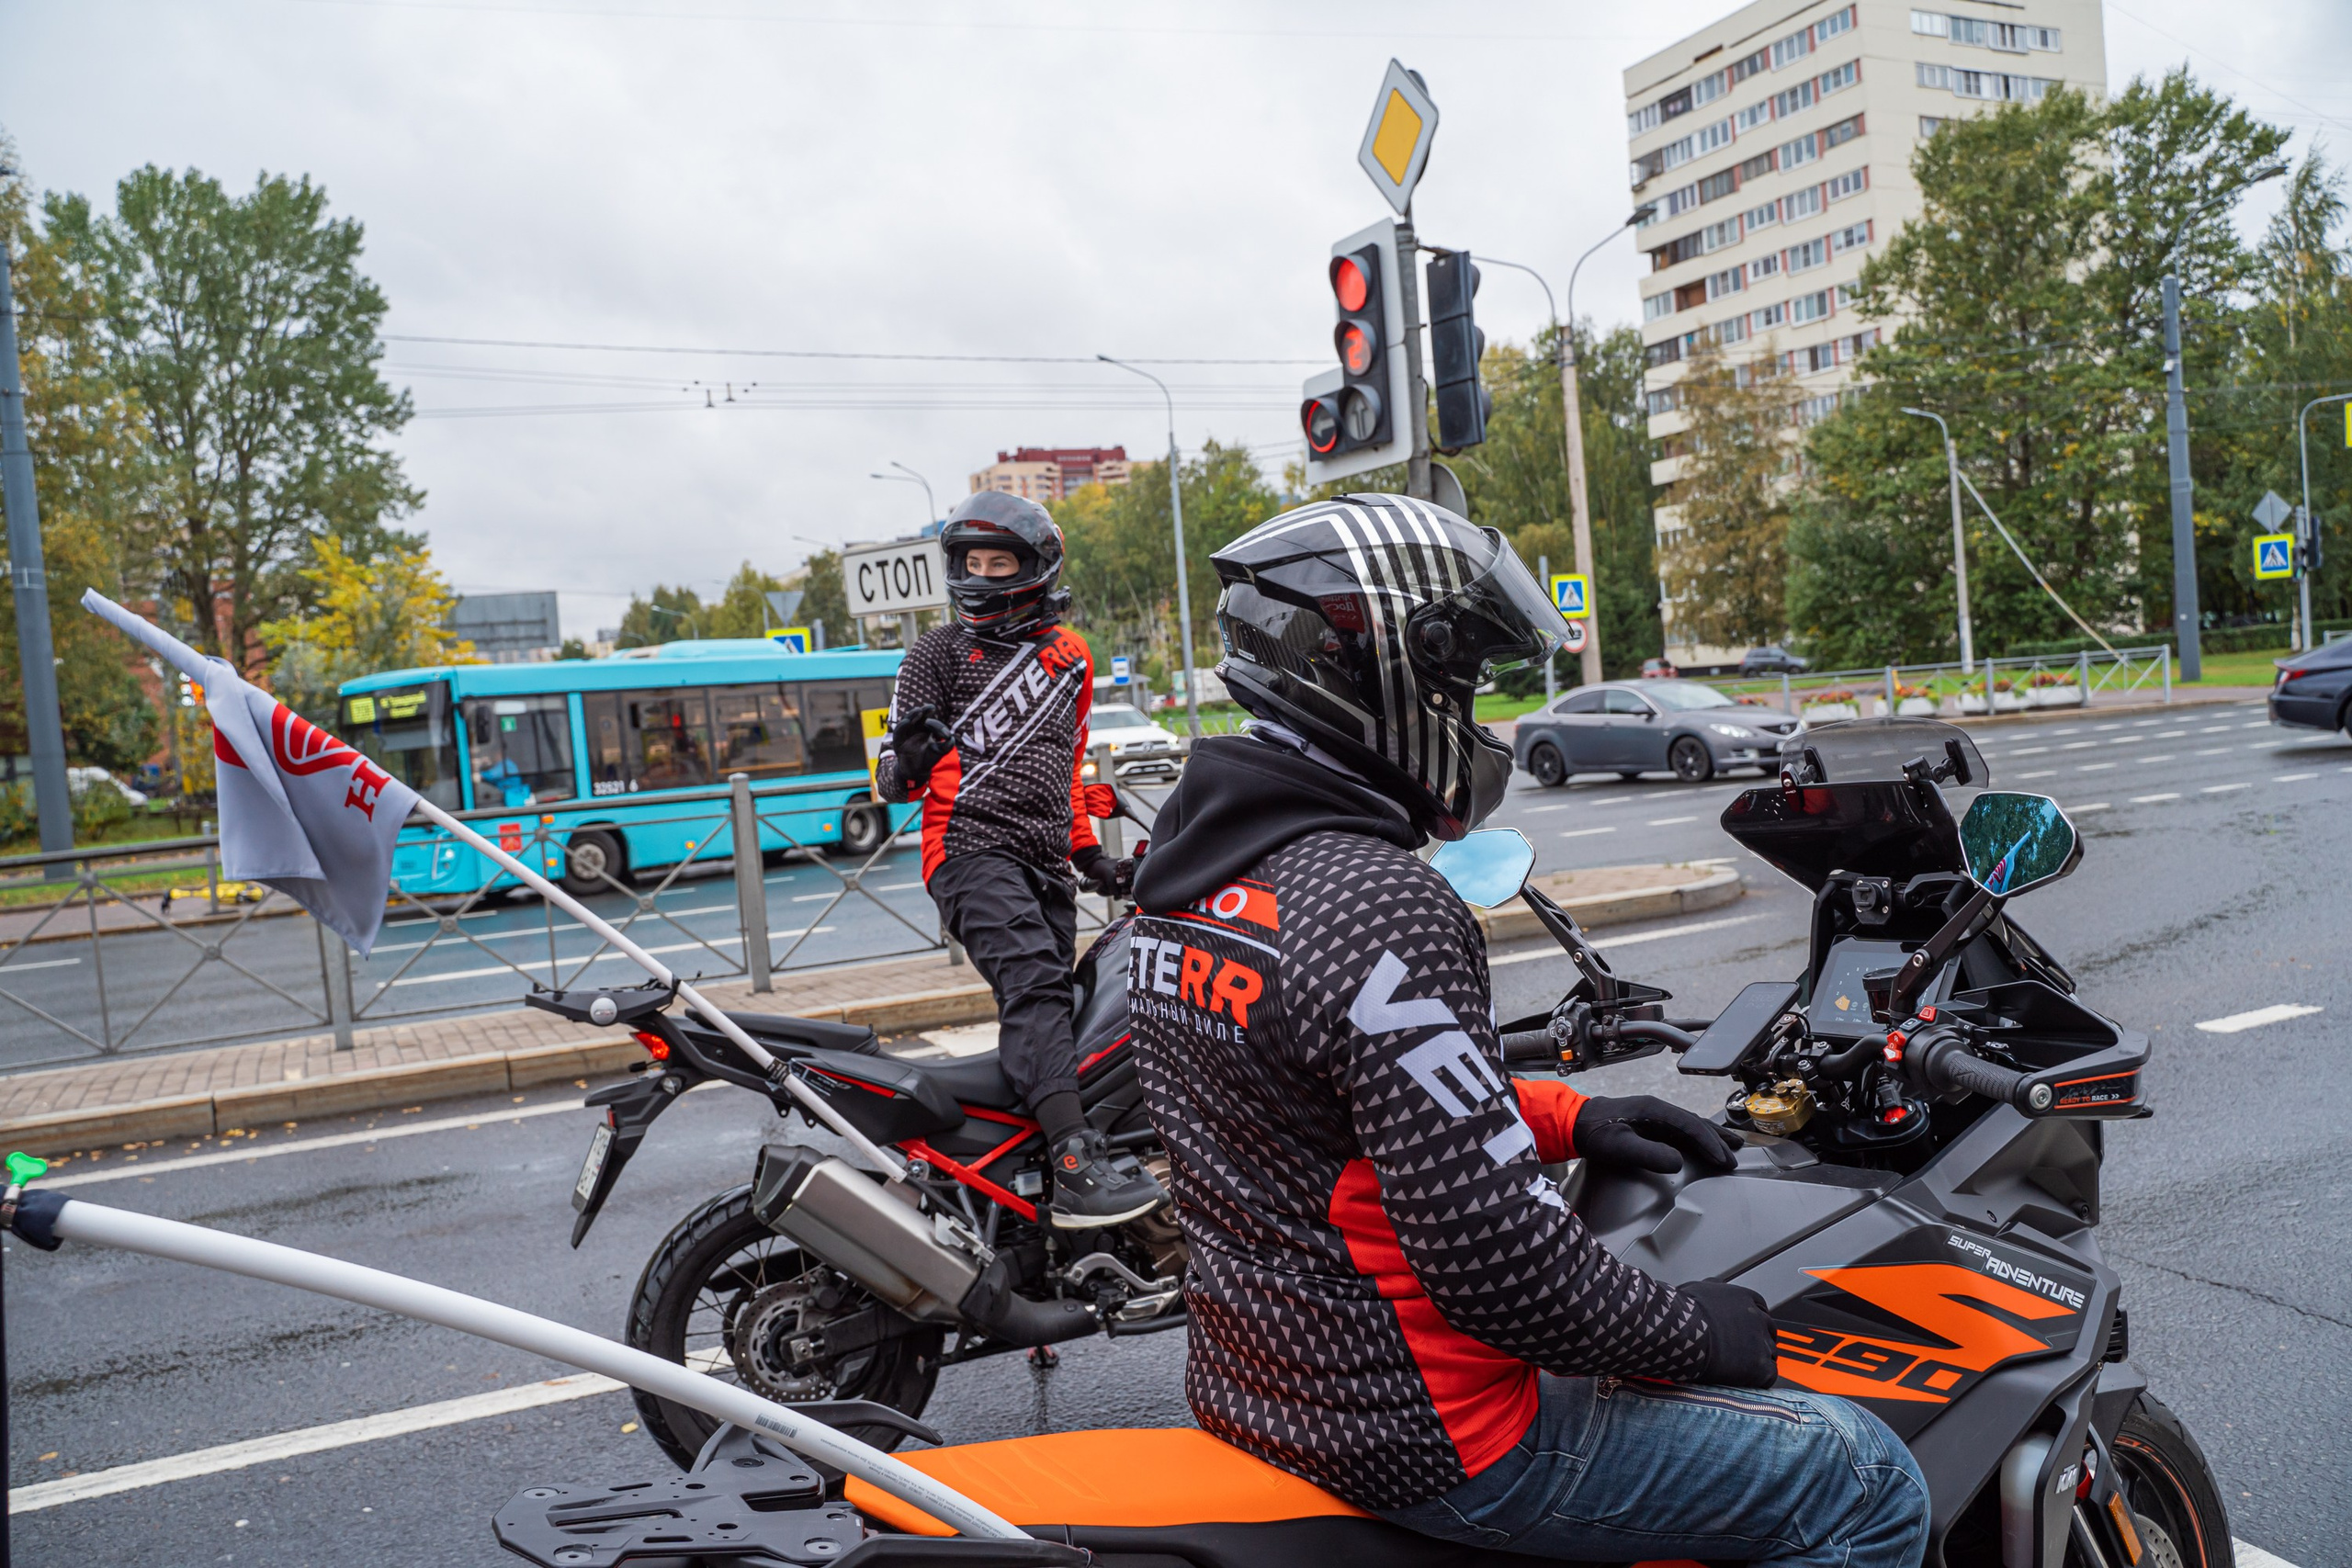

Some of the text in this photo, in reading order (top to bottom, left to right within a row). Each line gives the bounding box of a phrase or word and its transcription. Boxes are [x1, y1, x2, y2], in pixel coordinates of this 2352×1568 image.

[859, 553, 933, 604] СТОП
[1128, 998, 1189, 1026] ИАЛЬНЫЙ
[2091, 1093, 2109, 1102] RACE
[1948, 1235, 1992, 1259] SUPER
[1985, 1256, 2086, 1309] ADVENTURE
[2054, 1463, 2079, 1495] KTM
